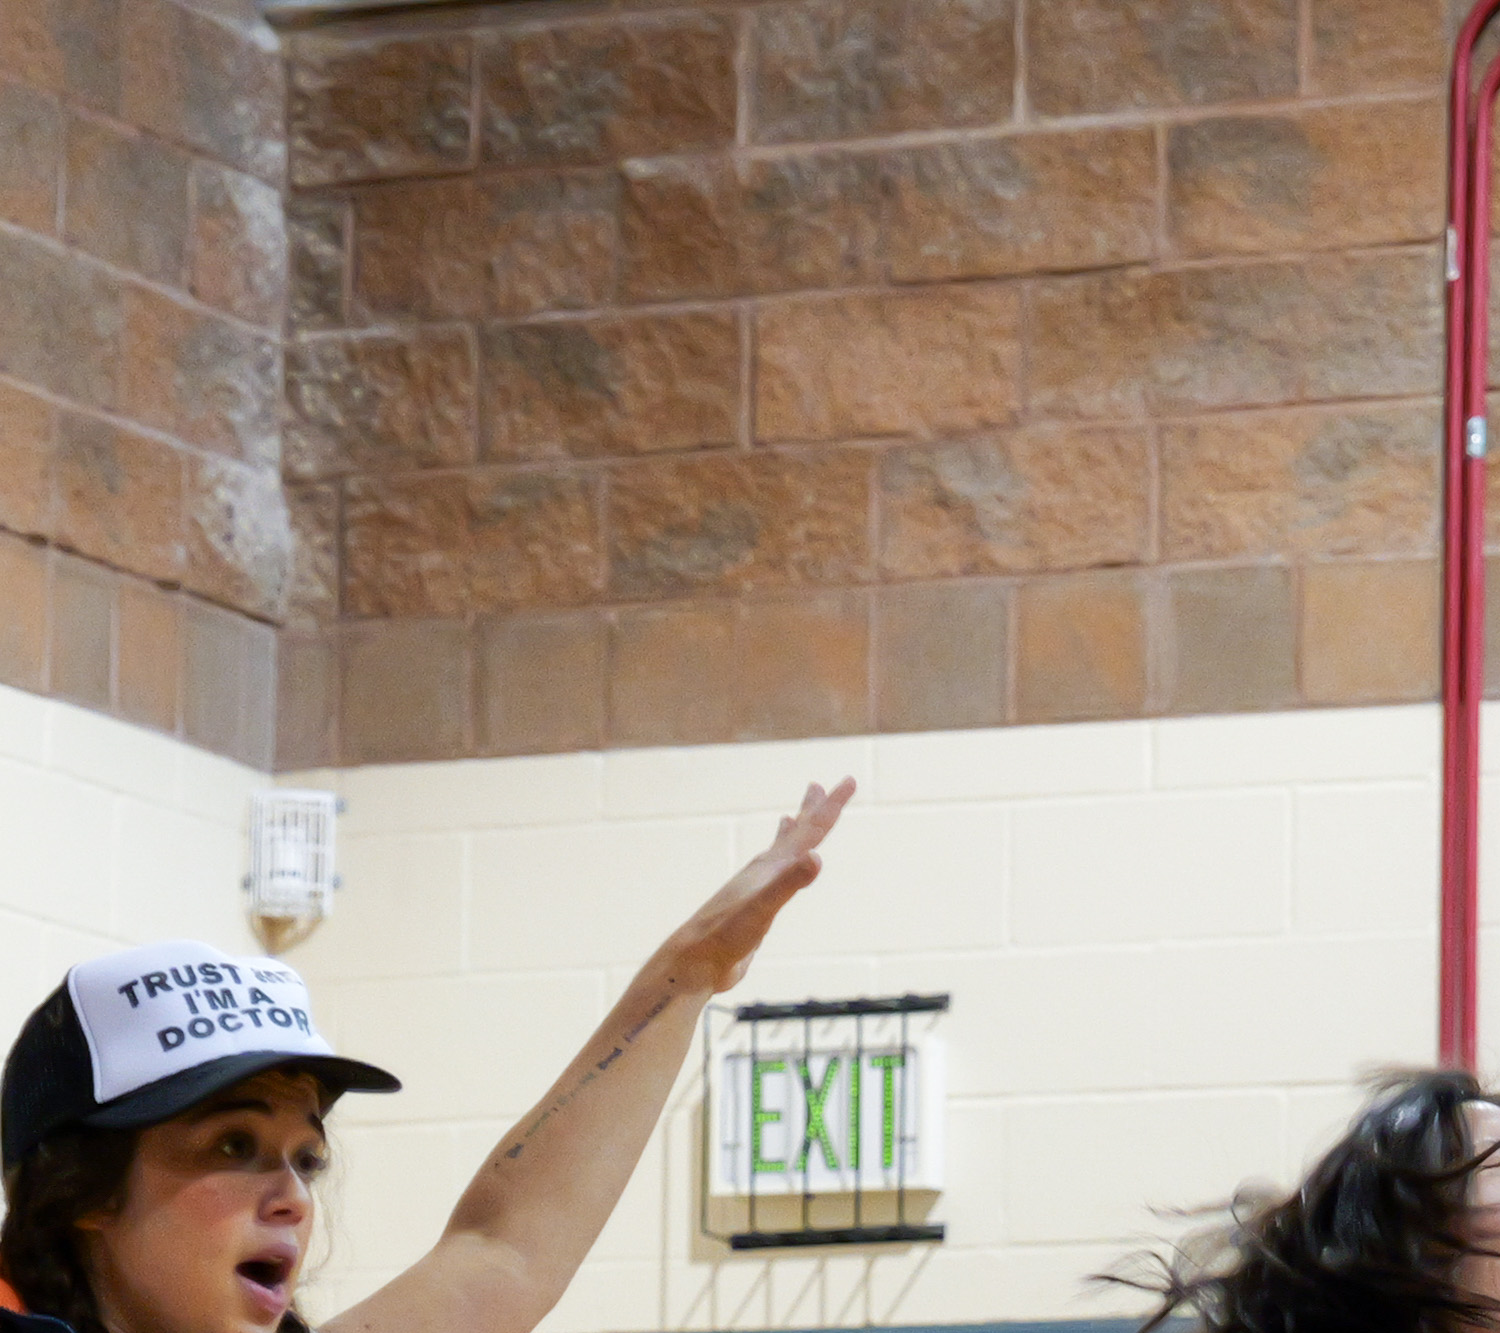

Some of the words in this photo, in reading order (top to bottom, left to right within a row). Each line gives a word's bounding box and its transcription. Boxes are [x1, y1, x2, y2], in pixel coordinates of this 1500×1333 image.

[117, 962, 243, 1009] TRUST
[183, 988, 239, 1015] I'M
[248, 986, 275, 1005] A
[156, 1006, 312, 1053] DOCTOR
[751, 1055, 906, 1173] EXIT
